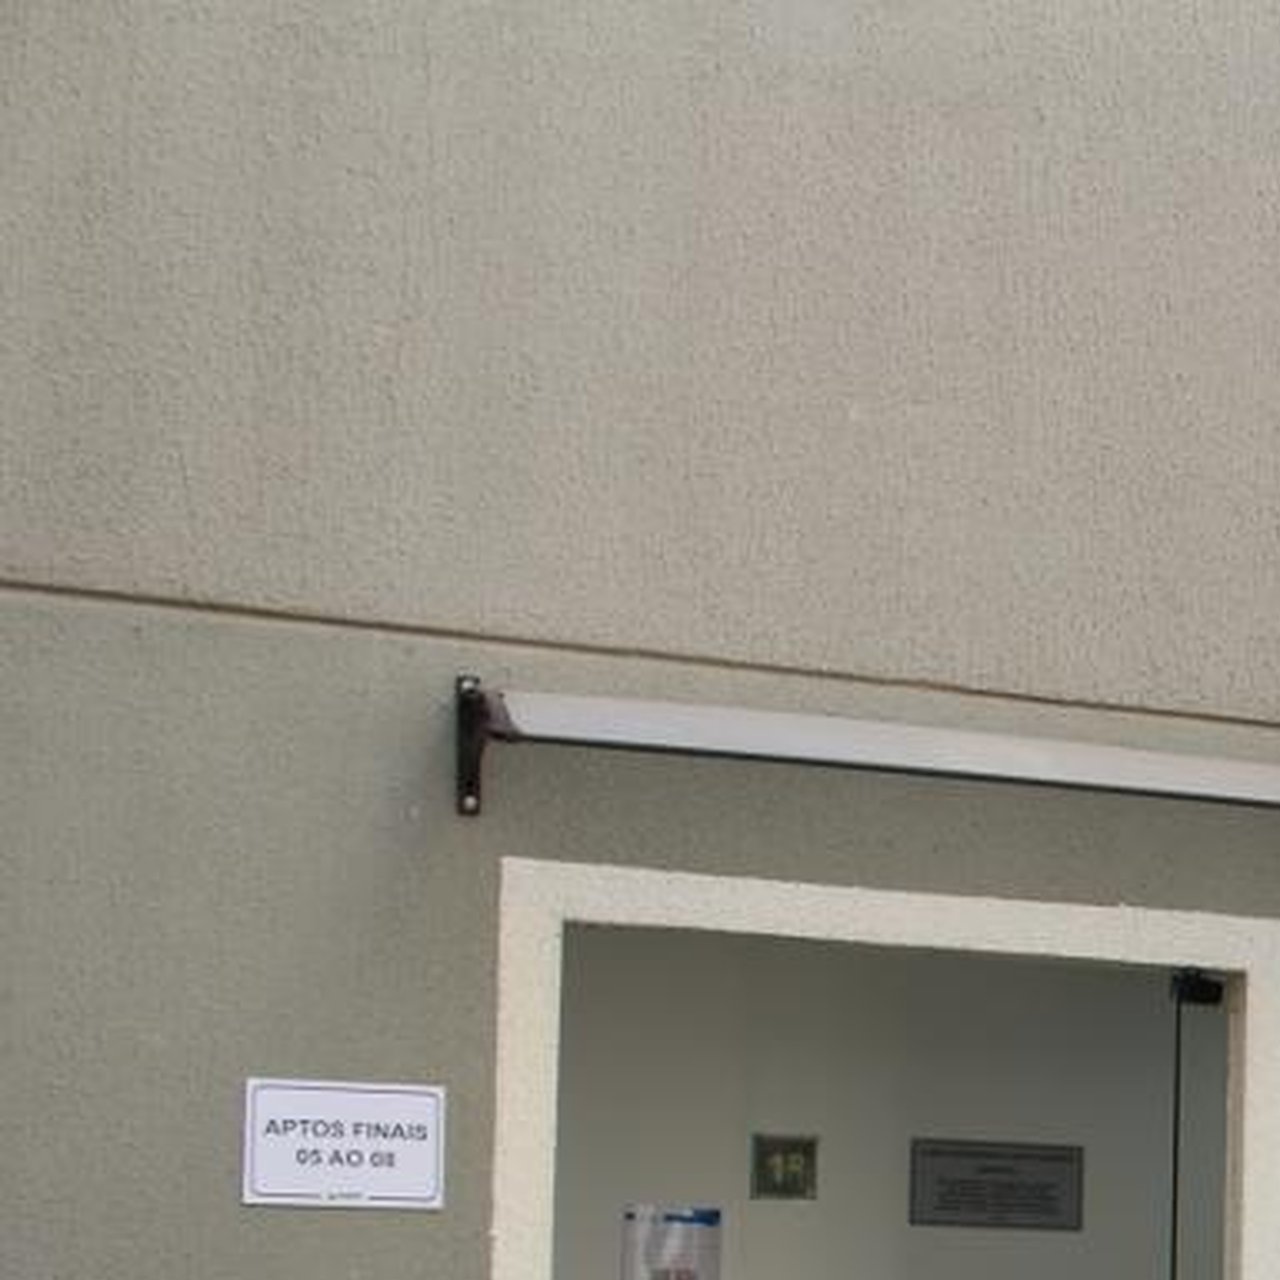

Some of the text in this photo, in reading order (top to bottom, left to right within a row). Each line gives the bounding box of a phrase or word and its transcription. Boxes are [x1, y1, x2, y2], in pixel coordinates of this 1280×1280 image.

[263, 1119, 428, 1141] APTOS FINAIS
[296, 1149, 323, 1166] 05
[328, 1150, 364, 1167] AO
